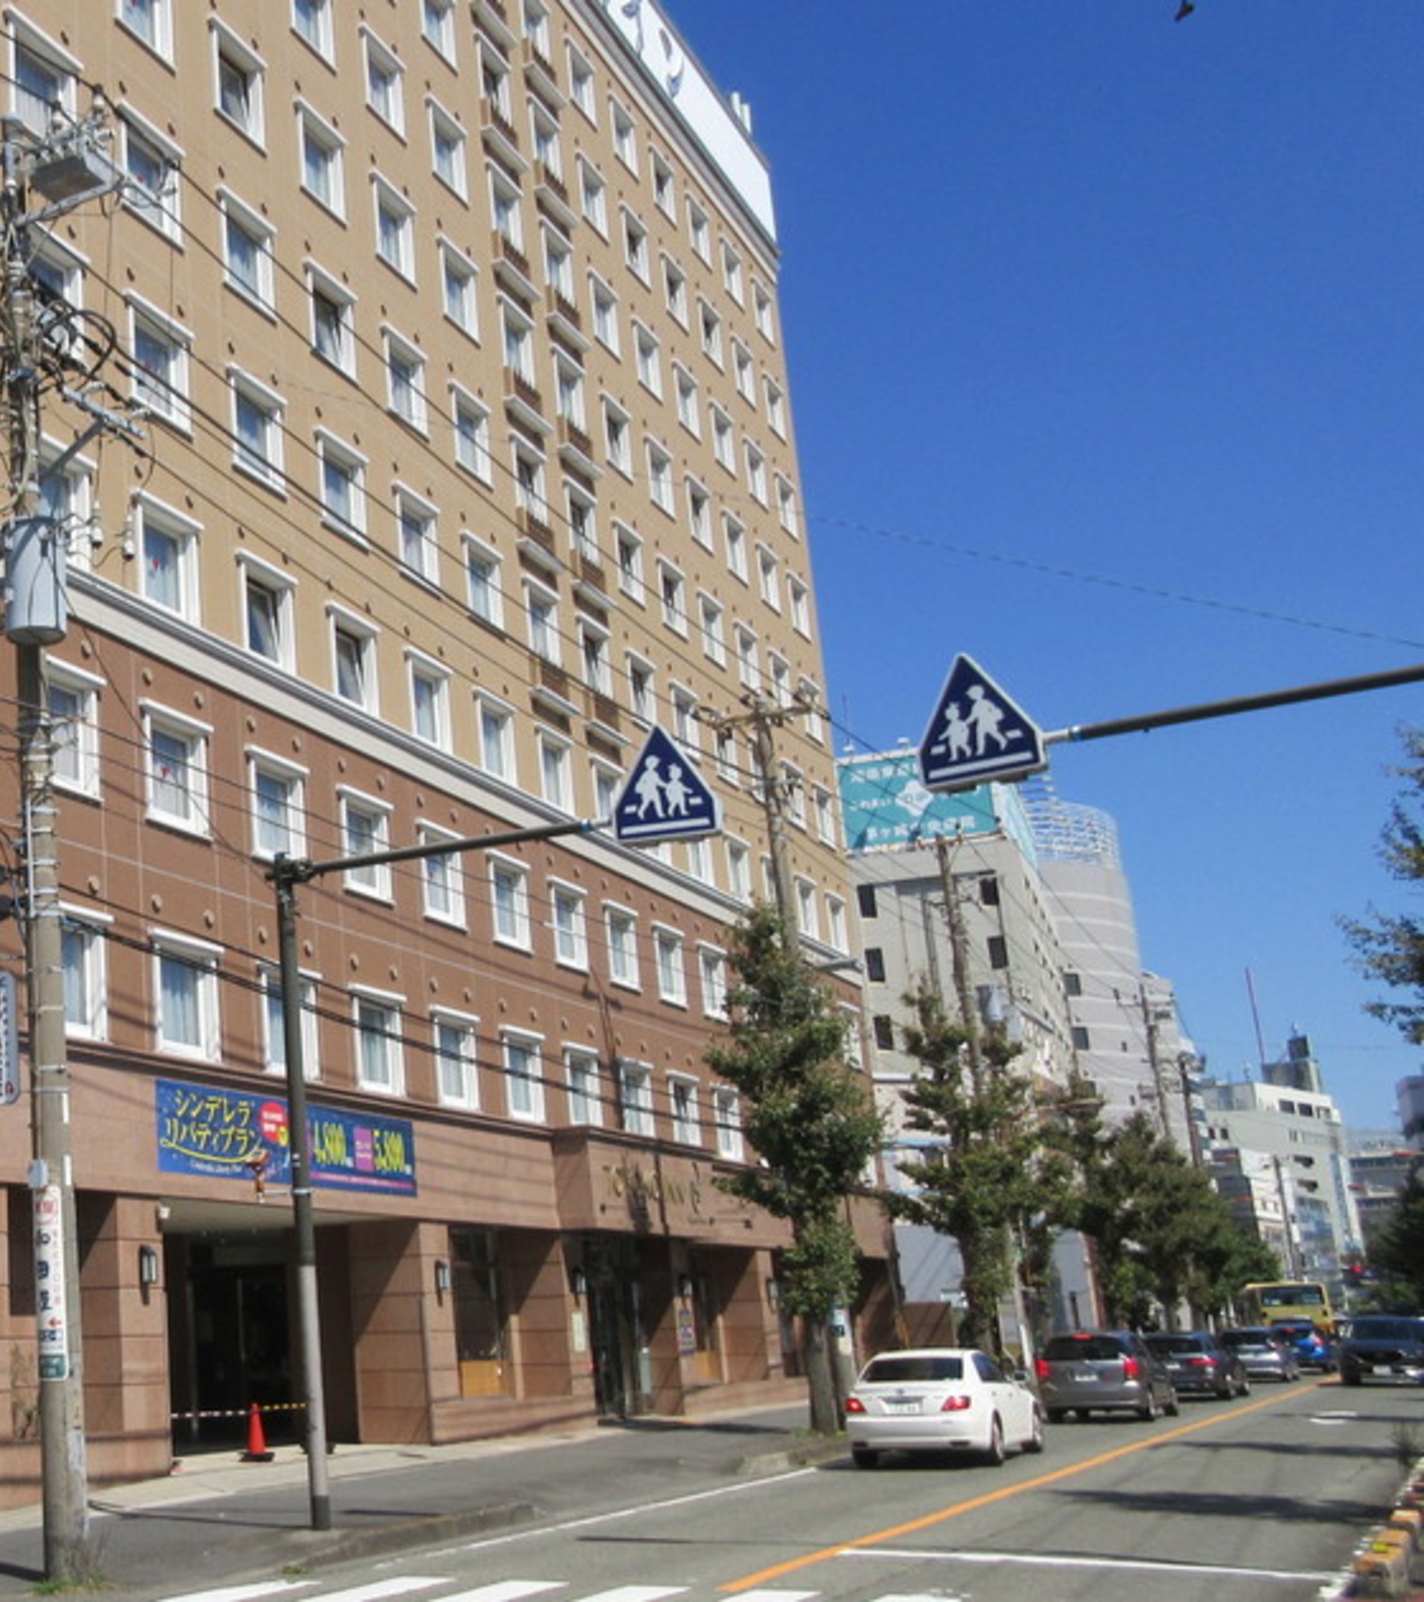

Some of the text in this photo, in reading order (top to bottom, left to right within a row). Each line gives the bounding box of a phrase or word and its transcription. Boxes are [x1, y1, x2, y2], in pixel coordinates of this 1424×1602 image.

[174, 1089, 252, 1127] シンデレラ
